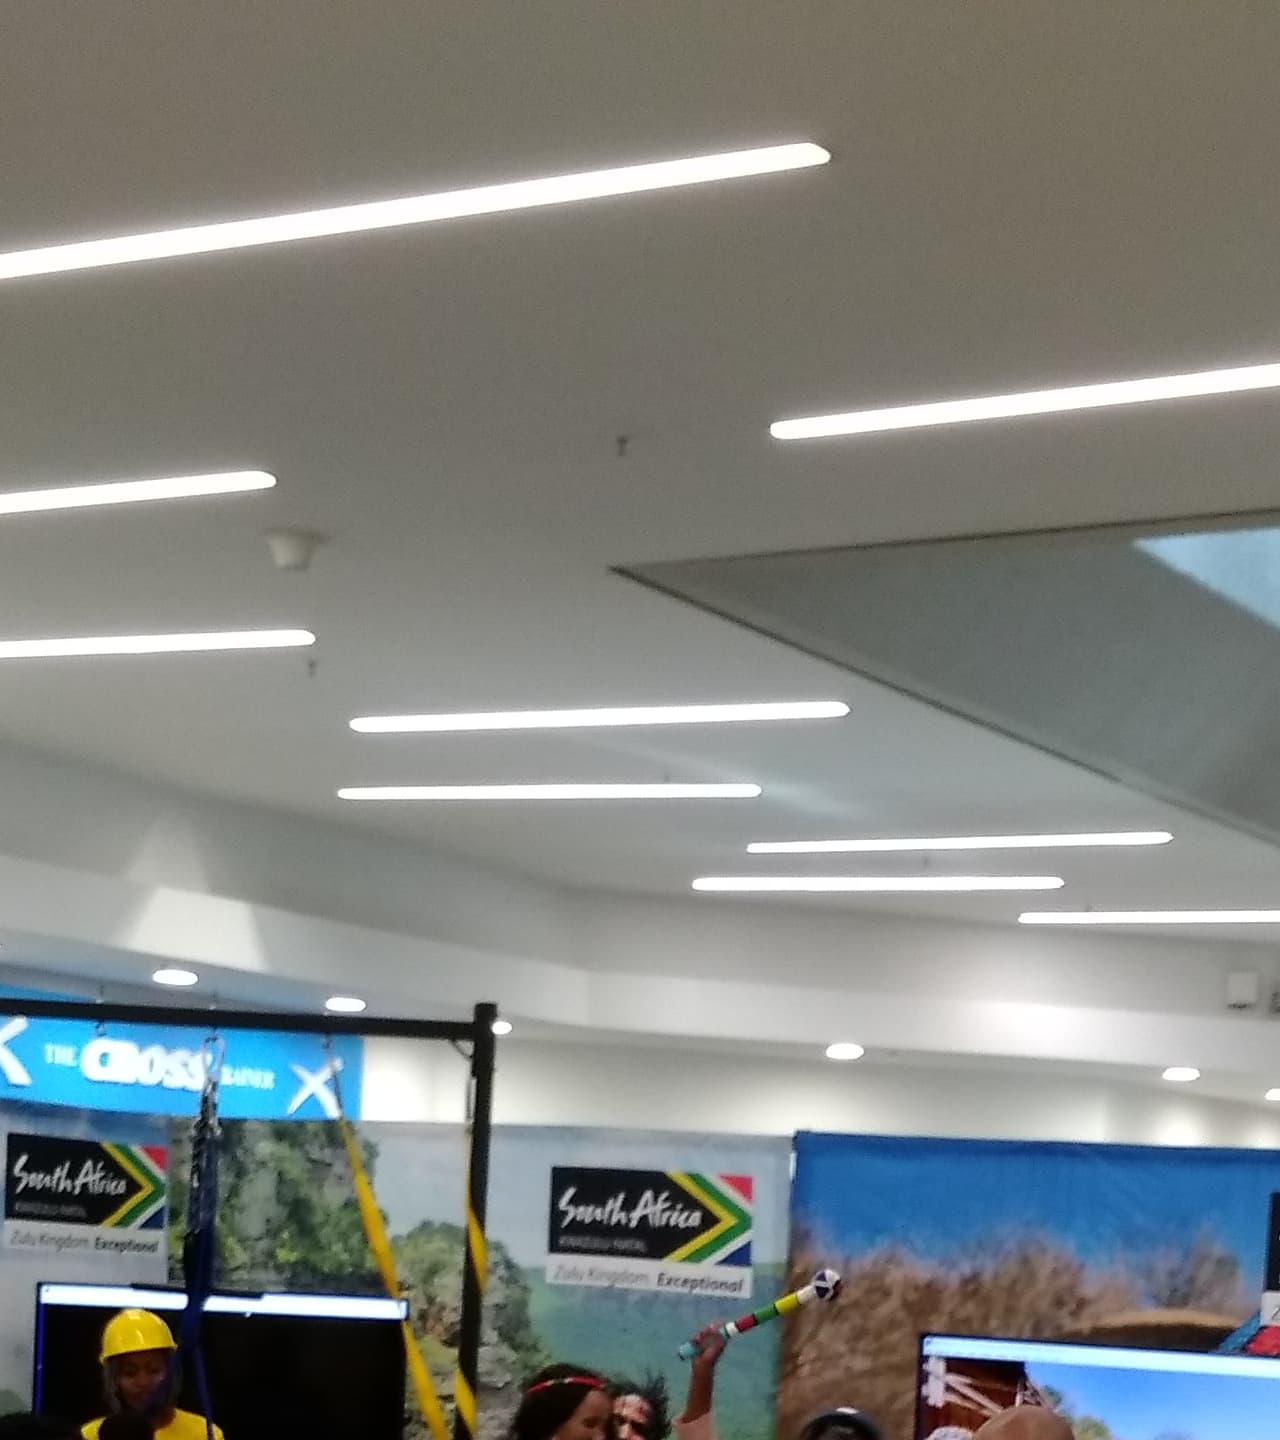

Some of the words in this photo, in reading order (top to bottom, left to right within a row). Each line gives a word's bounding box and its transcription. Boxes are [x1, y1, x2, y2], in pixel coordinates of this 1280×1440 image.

[13, 1153, 72, 1195] South
[70, 1159, 128, 1196] Africa
[558, 1186, 628, 1229] South
[627, 1188, 703, 1229] Africa
[94, 1237, 160, 1254] Exceptional
[656, 1272, 744, 1296] Exceptional
